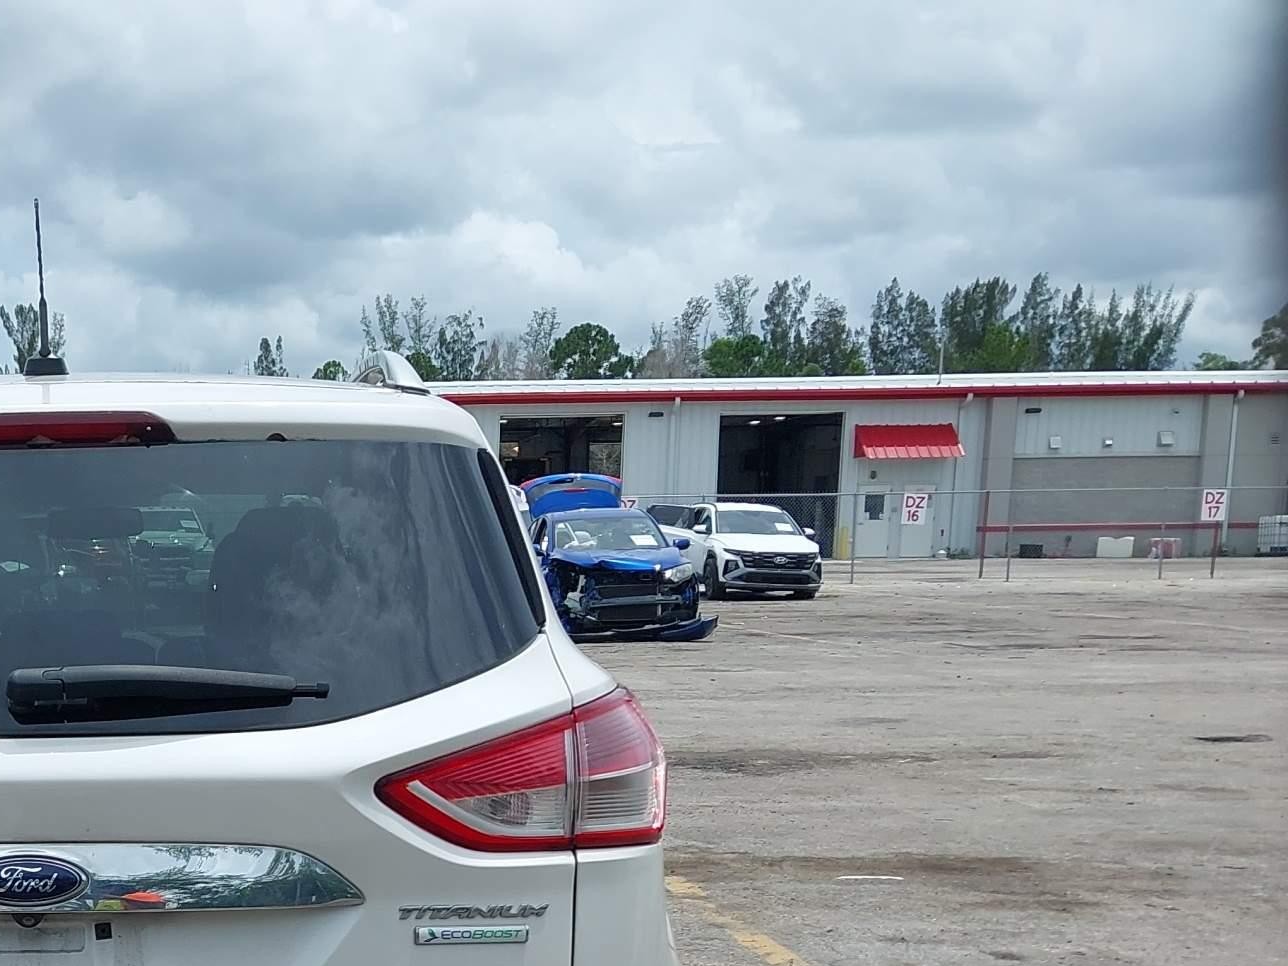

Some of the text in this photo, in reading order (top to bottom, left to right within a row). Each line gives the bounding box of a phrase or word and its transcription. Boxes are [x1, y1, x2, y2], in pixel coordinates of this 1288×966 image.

[905, 495, 926, 509] DZ
[1205, 491, 1225, 505] DZ
[907, 509, 919, 522] 16
[1208, 505, 1220, 519] 17
[398, 903, 550, 921] TITANIUM
[440, 929, 523, 940] ECOBOOST
